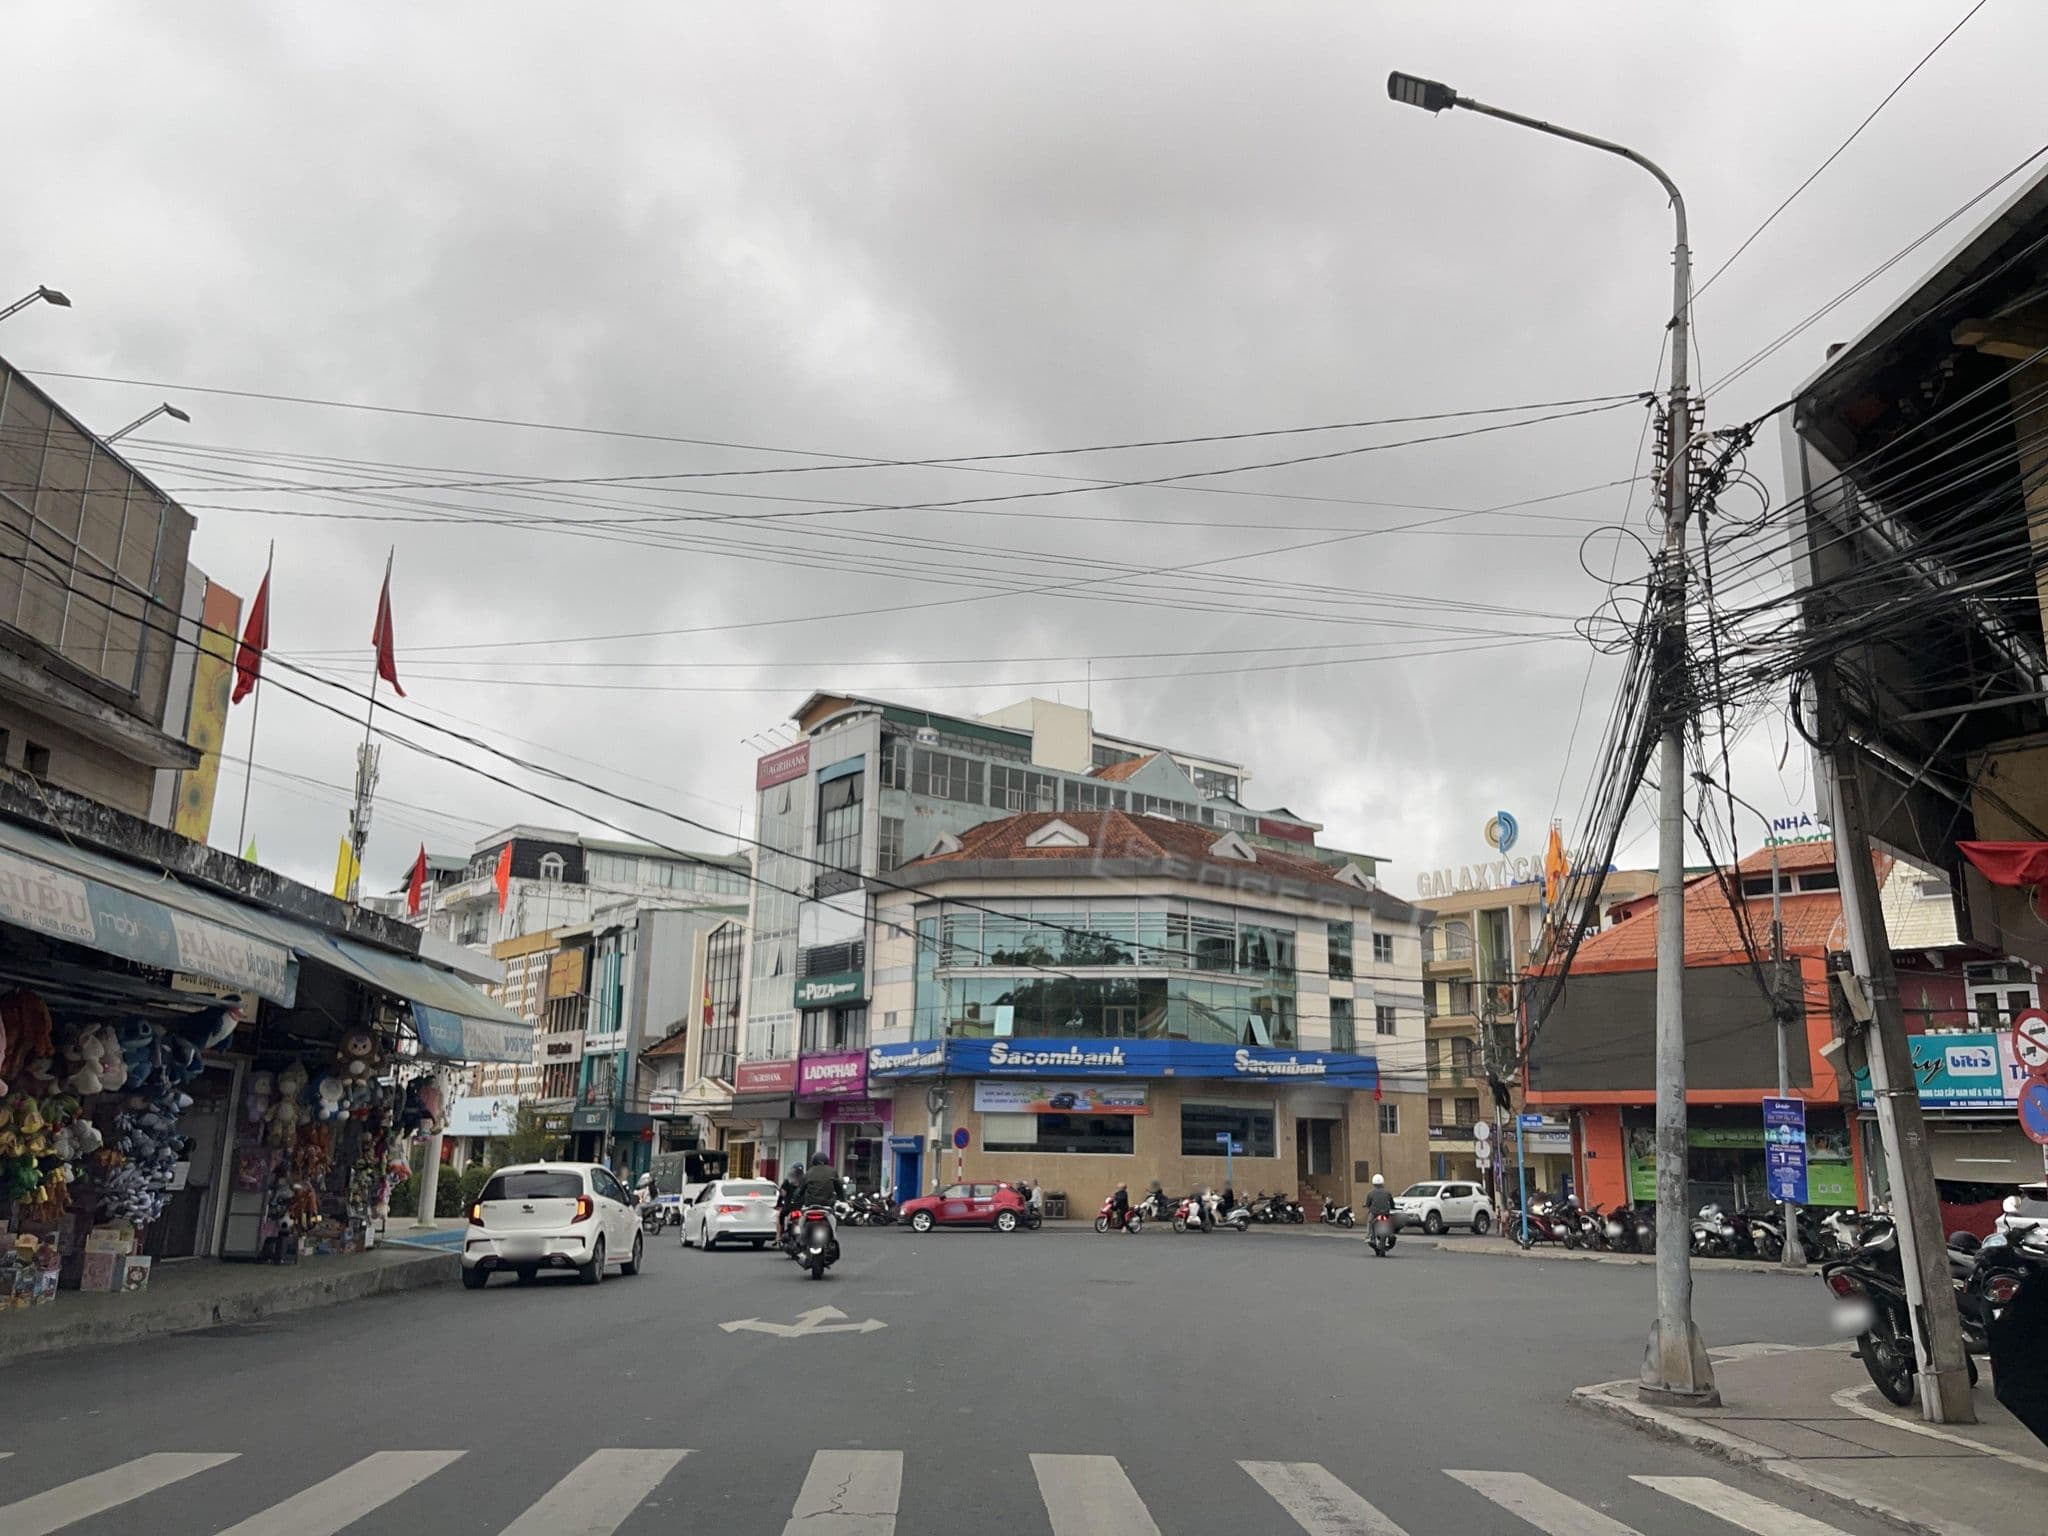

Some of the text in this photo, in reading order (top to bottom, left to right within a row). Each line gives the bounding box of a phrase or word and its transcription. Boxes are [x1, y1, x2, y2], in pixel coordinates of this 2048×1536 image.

[1773, 811, 1811, 831] NHÀ
[1417, 860, 1505, 897] GALAXY
[806, 983, 835, 1000] PIZZA
[989, 1041, 1126, 1066] Sacombank
[1234, 1048, 1326, 1075] Sacombank
[804, 1062, 858, 1080] LADOPHAR
